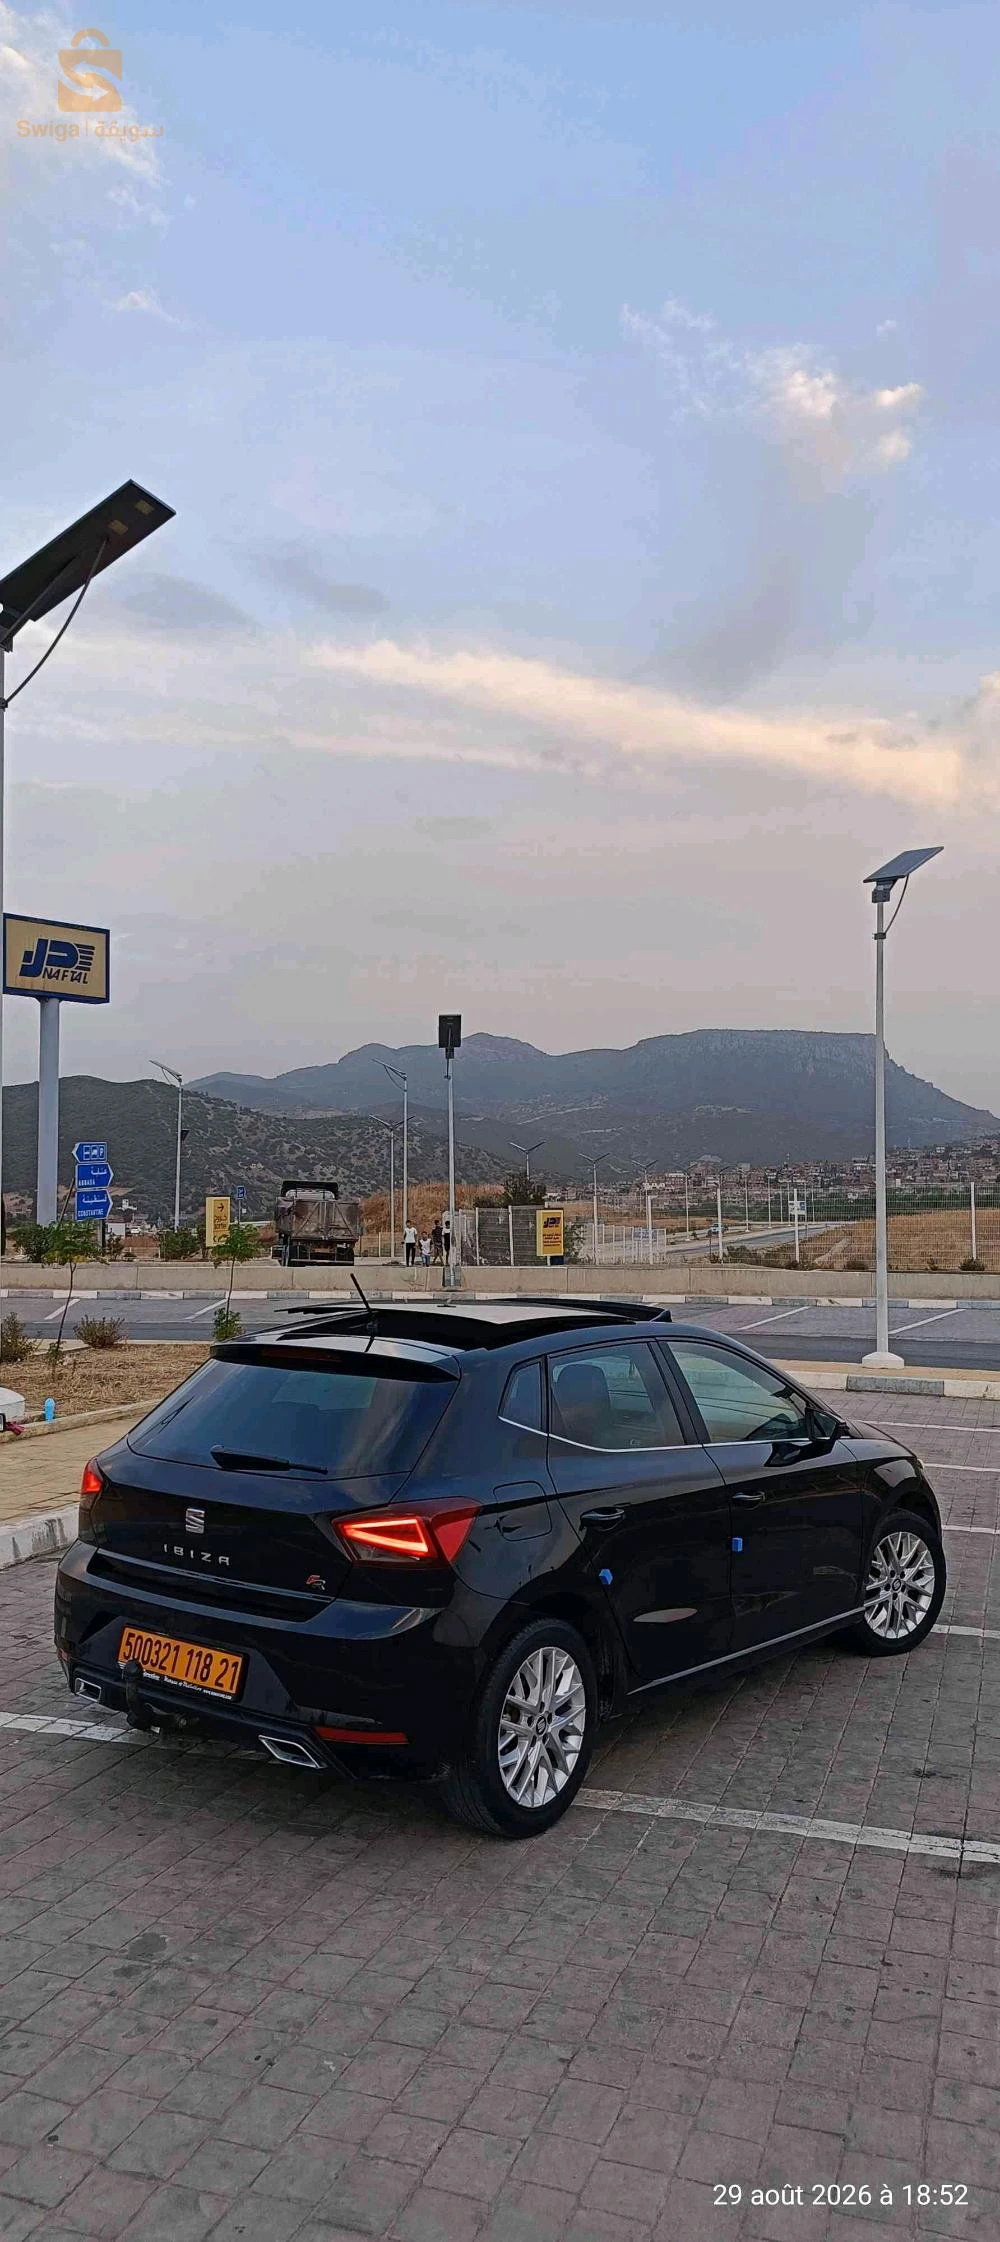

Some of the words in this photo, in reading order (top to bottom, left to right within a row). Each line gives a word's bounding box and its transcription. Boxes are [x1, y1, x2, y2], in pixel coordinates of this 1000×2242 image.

[42, 967, 88, 984] NAFTAL
[77, 1208, 104, 1217] CONSTANTINE
[163, 1543, 231, 1566] IBIZA
[123, 1632, 180, 1674] 500321
[184, 1648, 213, 1682] 118
[214, 1657, 239, 1690] 21
